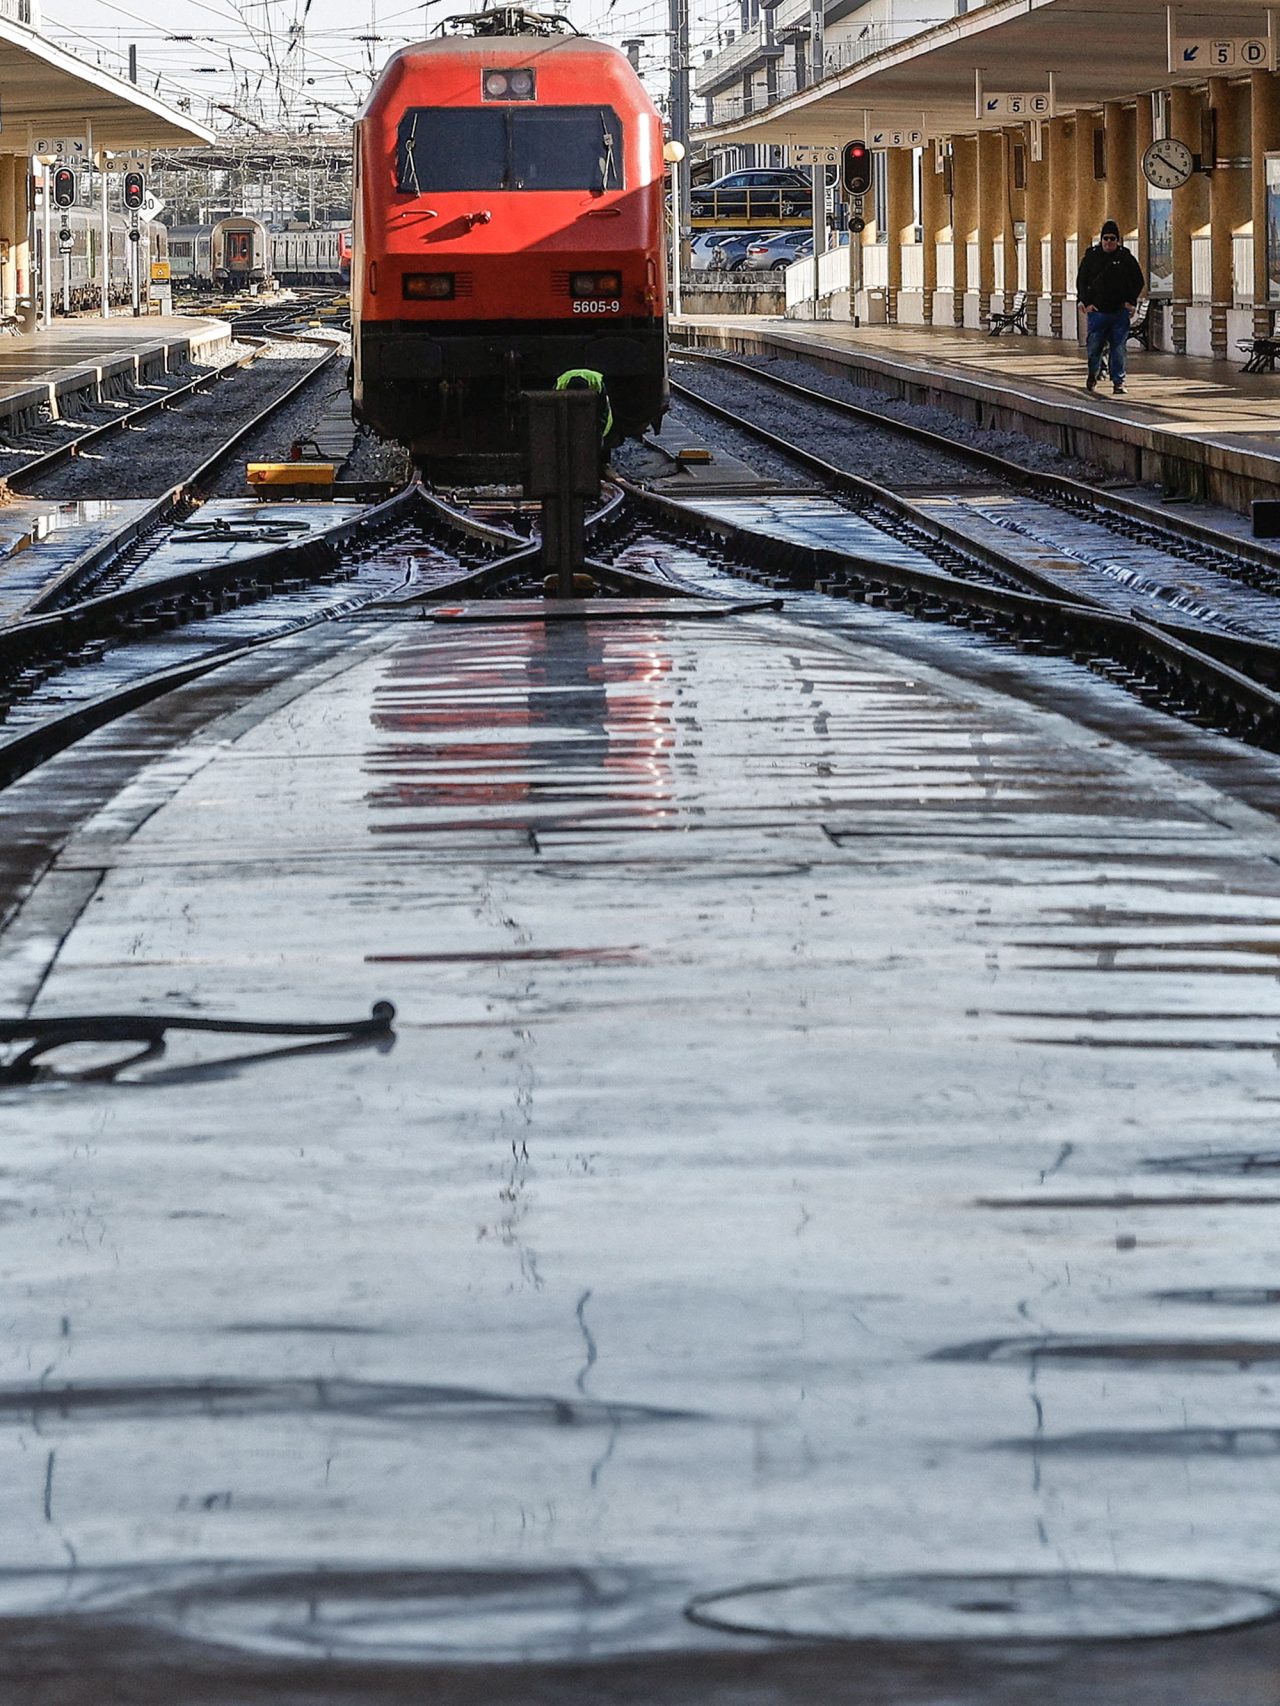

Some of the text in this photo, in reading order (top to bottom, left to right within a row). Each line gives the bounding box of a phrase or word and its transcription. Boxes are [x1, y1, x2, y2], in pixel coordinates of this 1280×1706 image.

[1218, 46, 1260, 63] 5 D
[1013, 99, 1044, 112] 5 E
[894, 133, 918, 144] 5 F
[38, 142, 62, 152] F 3
[572, 301, 620, 313] 5605-9
